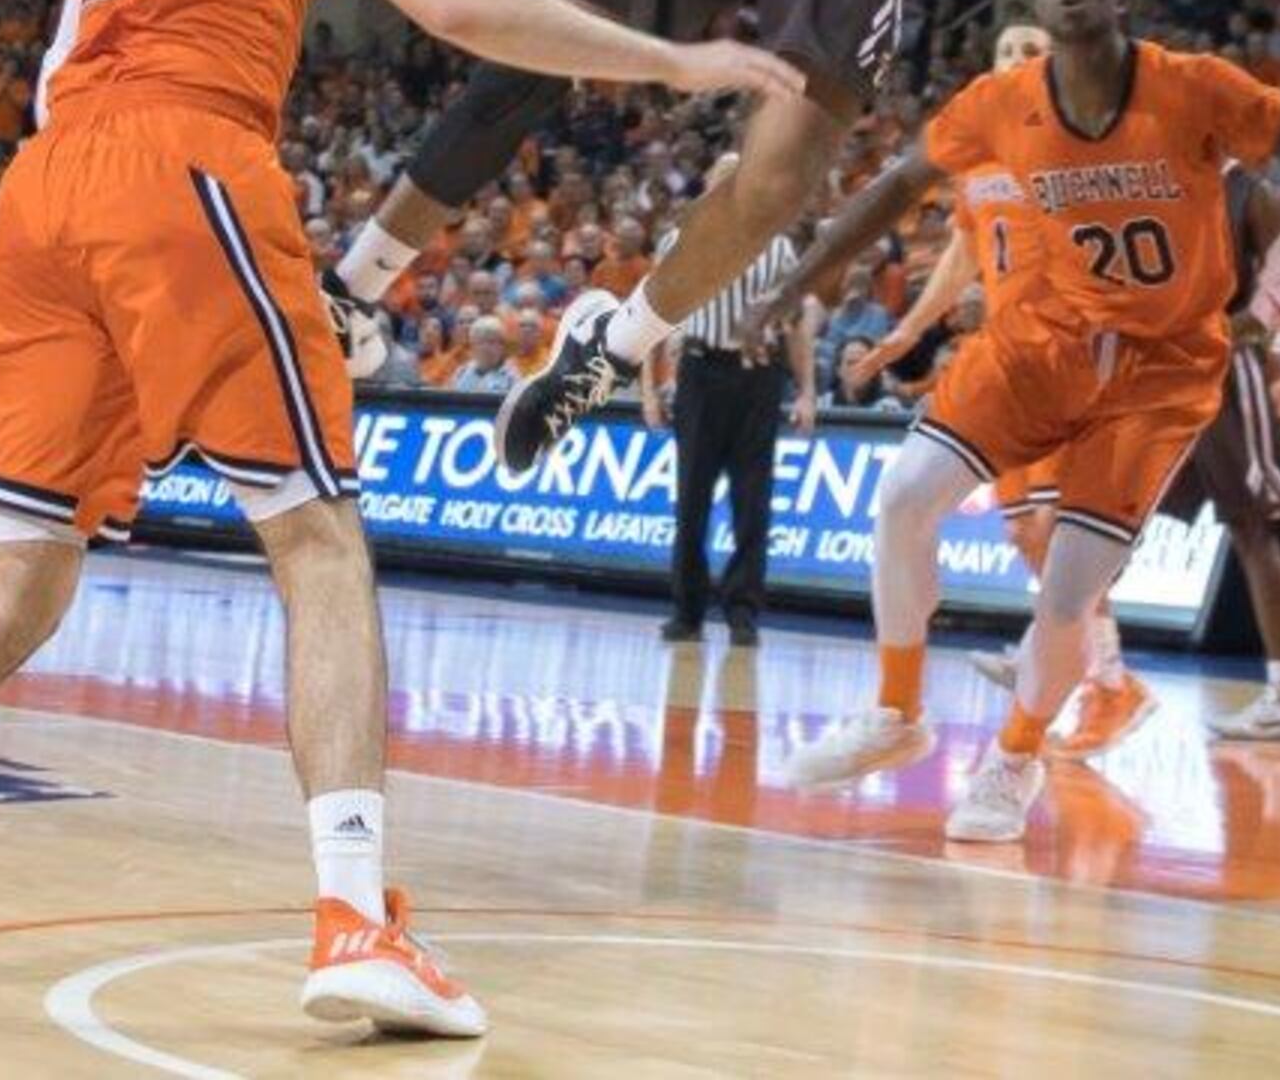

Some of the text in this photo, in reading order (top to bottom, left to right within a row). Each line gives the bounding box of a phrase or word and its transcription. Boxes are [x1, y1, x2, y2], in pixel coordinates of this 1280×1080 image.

[1071, 217, 1177, 286] 20
[440, 498, 500, 532] HOLY
[500, 500, 577, 540] CROSS
[937, 536, 1019, 576] NAVY
